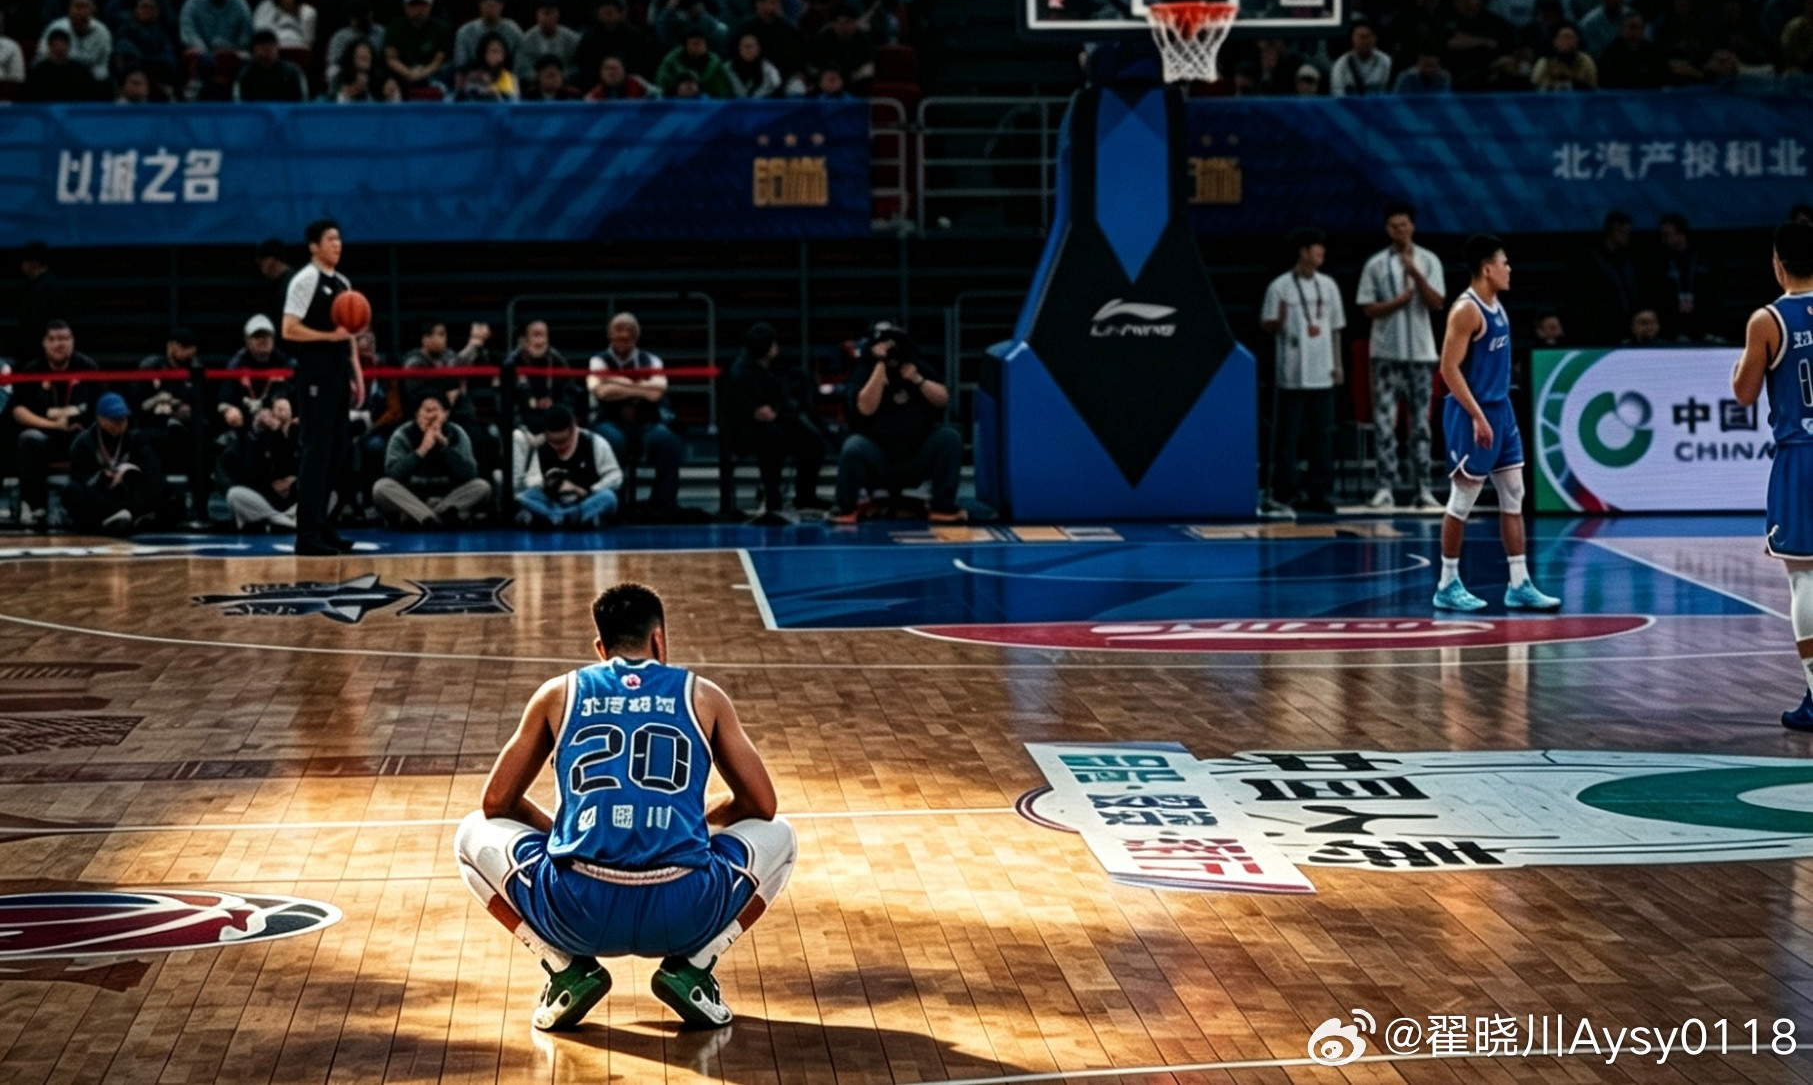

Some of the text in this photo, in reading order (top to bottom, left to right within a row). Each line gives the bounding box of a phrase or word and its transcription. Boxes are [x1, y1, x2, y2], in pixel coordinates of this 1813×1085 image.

[56, 146, 223, 205] 以城之名
[569, 722, 692, 795] 20
